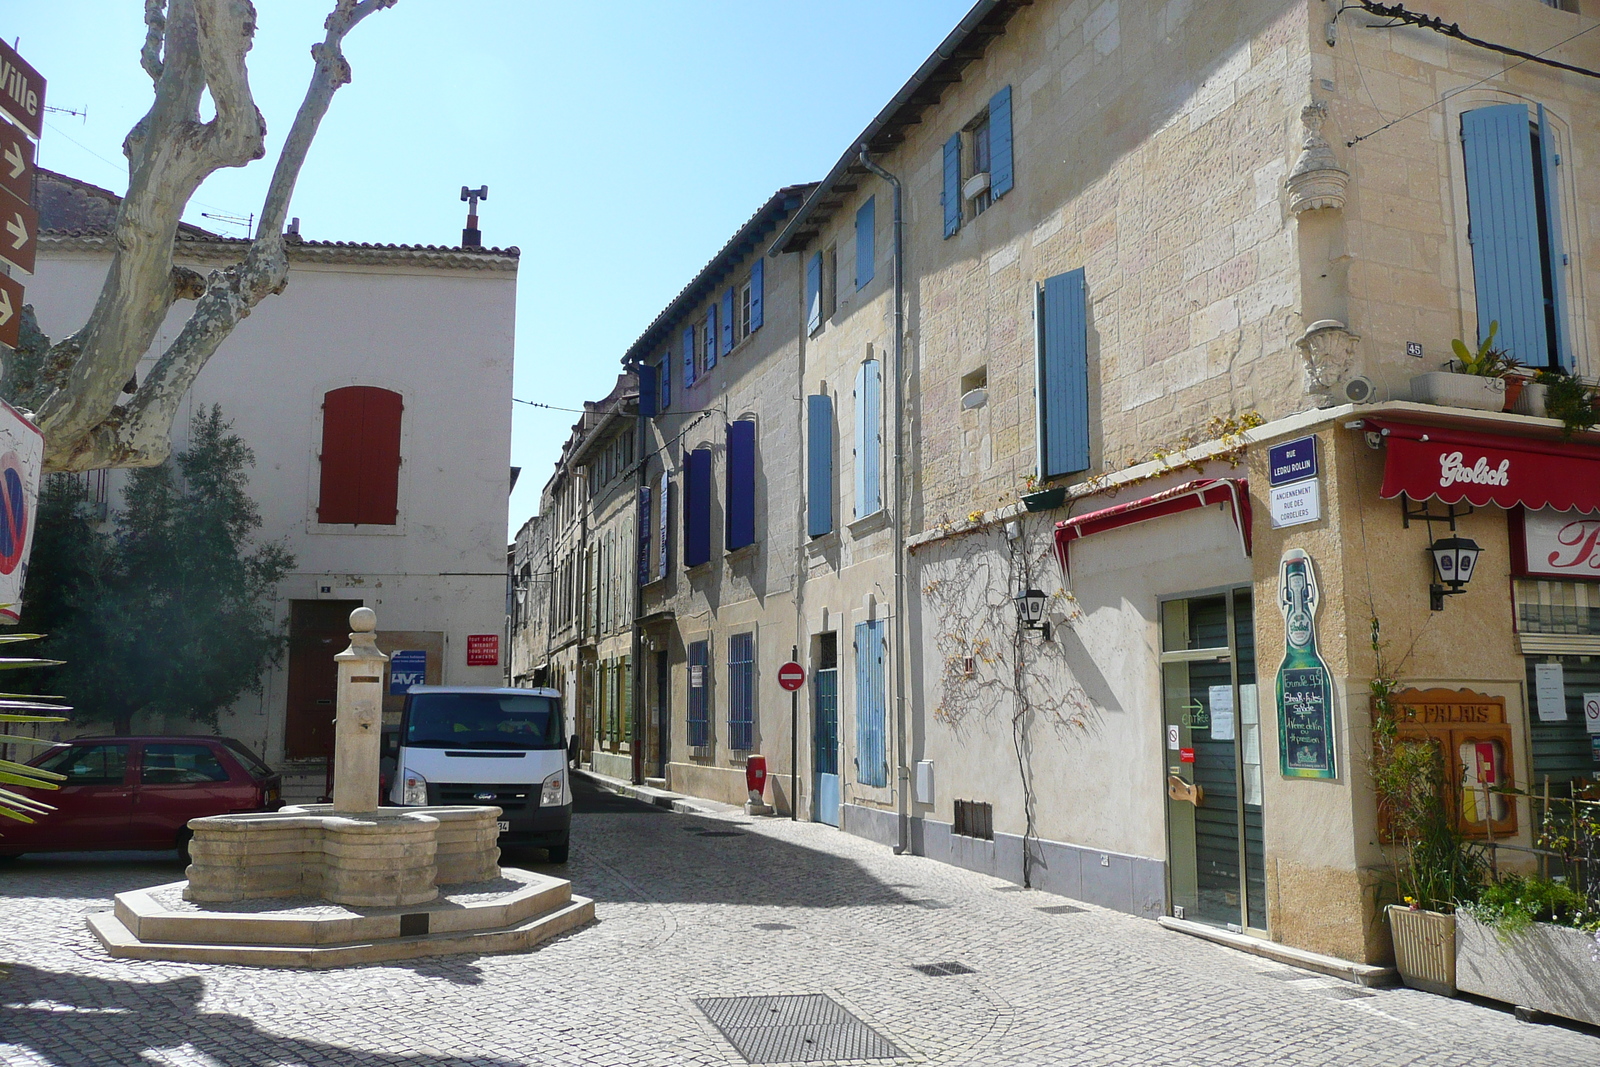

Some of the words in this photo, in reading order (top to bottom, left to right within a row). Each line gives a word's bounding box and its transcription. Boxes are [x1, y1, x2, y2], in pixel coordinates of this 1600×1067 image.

[0, 54, 38, 116] Ville
[1409, 344, 1421, 355] 45
[1286, 449, 1296, 459] RUE
[1274, 465, 1291, 477] LEDRU
[1291, 459, 1311, 473] ROLLIN
[1439, 451, 1510, 487] Grolsch
[1276, 486, 1311, 501] ANCIENNEMENT
[1284, 501, 1293, 509] RUE
[1294, 498, 1304, 507] DES
[1280, 508, 1309, 521] CORDELIERS
[1423, 704, 1489, 723] PALAIS
